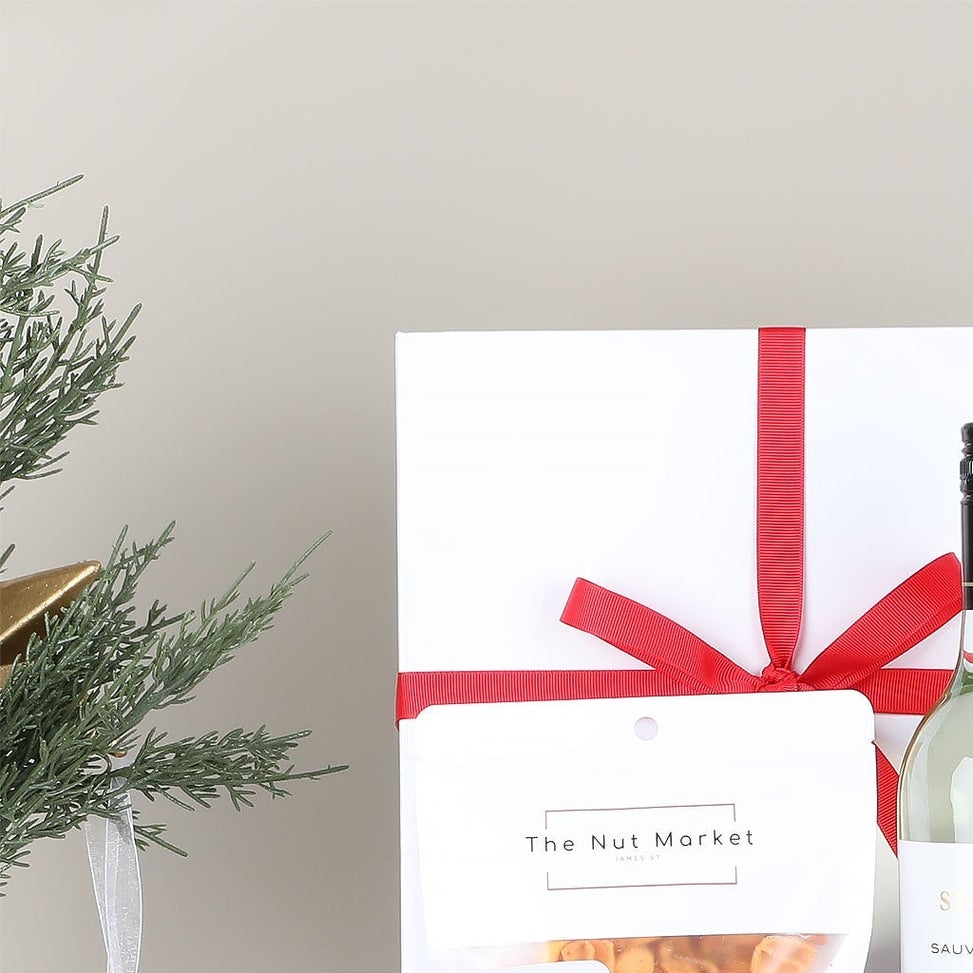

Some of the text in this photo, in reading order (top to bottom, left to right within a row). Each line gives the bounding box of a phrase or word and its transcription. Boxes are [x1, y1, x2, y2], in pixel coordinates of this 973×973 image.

[525, 829, 754, 852] The Nut Market
